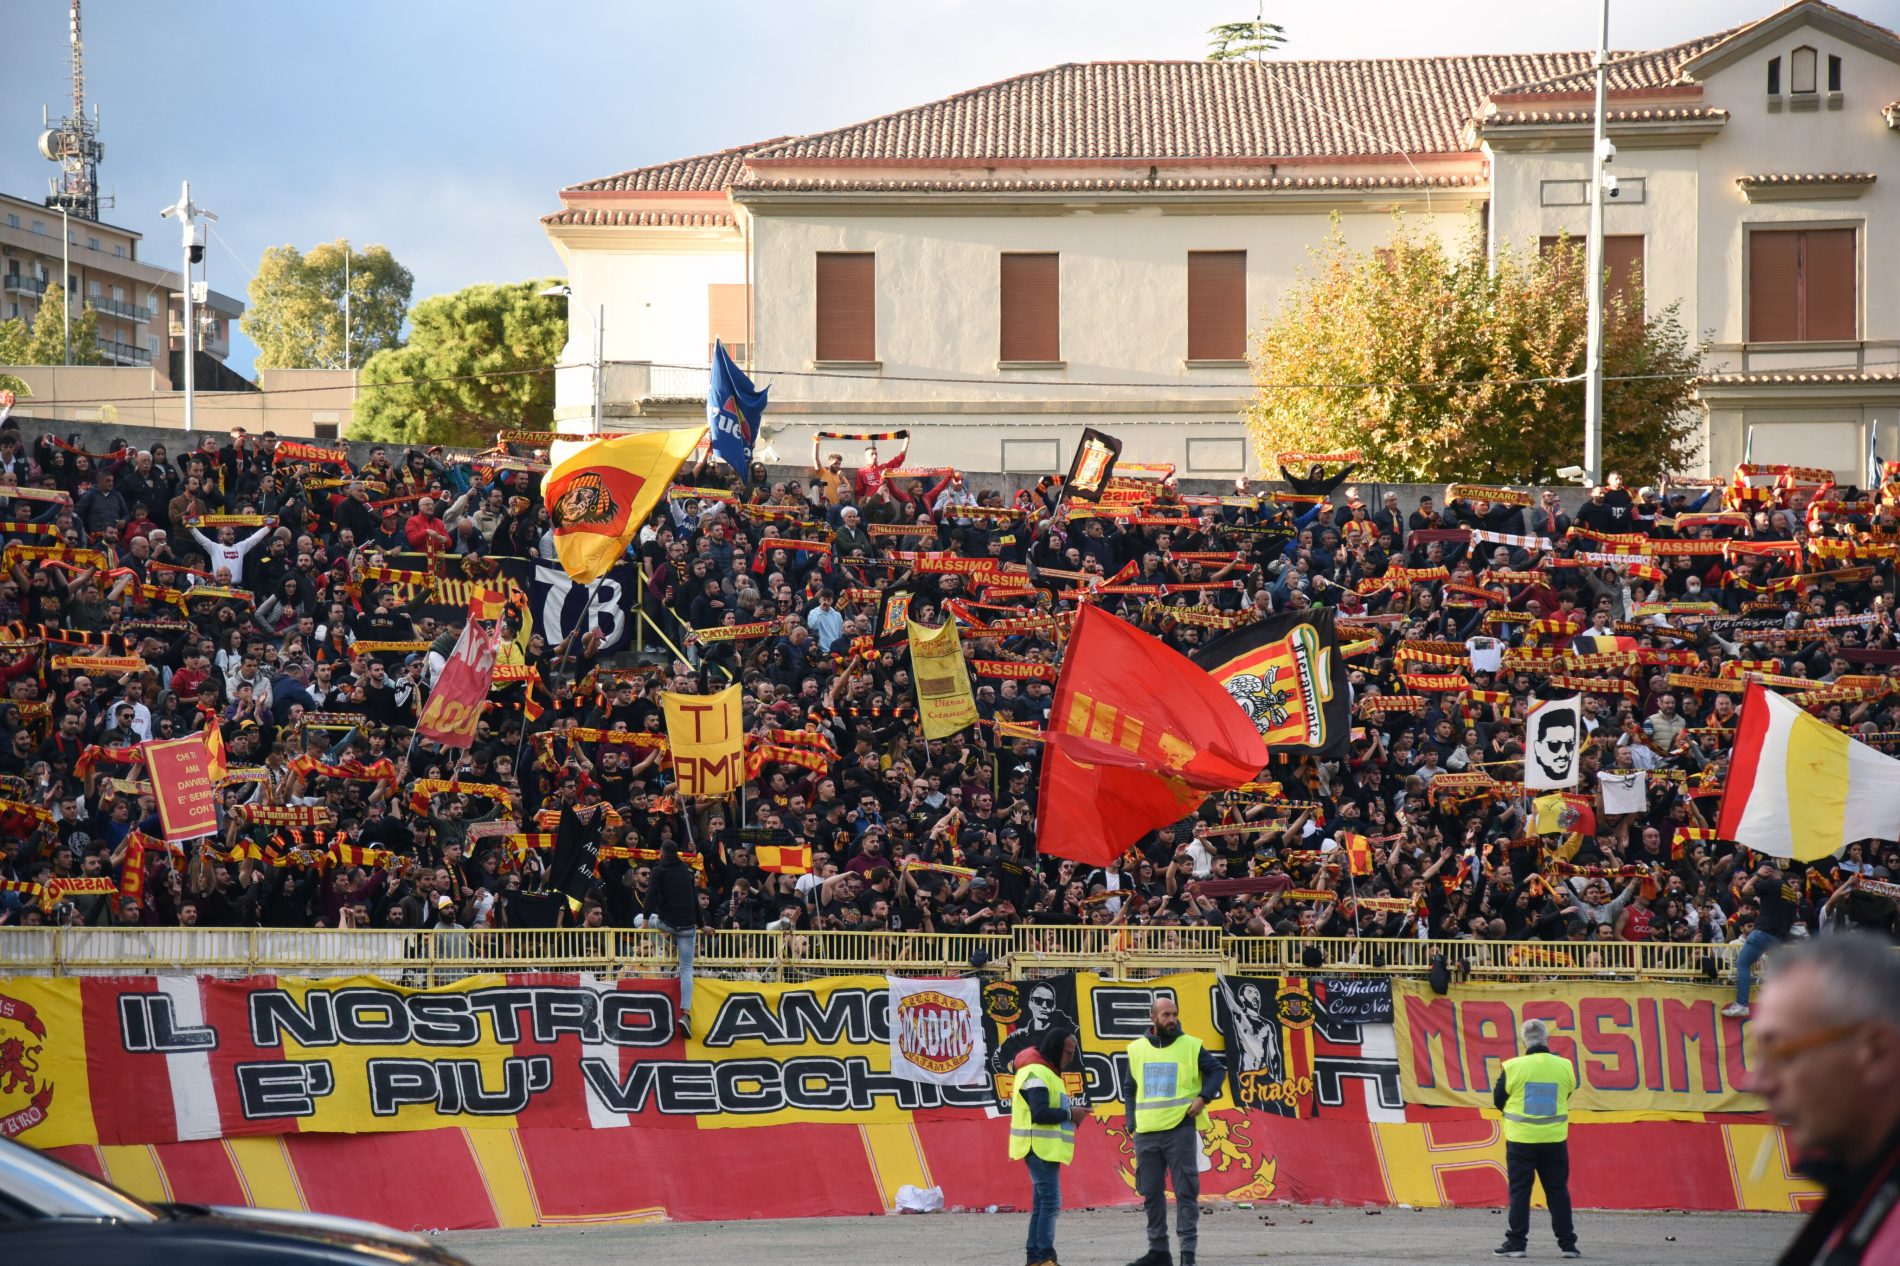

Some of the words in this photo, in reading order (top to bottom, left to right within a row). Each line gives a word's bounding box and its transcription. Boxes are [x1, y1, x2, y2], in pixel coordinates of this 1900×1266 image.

[1460, 488, 1517, 500] CATANZARO
[1651, 541, 1724, 553] MASSIMO
[920, 560, 993, 572] MASSIMO
[701, 625, 765, 640] CATANZARO
[1293, 643, 1318, 738] Fieramente
[934, 698, 966, 708] Ultras
[680, 703, 728, 743] TI
[176, 752, 190, 762] CHI
[185, 765, 200, 774] AMA
[178, 777, 209, 790] DAVVERO
[1436, 775, 1469, 783] ULTRAS
[189, 806, 208, 817] CON
[1327, 979, 1389, 998] Diffidati
[1330, 998, 1357, 1015] Con
[1361, 998, 1392, 1015] Noi
[118, 992, 219, 1053] IL
[249, 986, 675, 1047] NOSTRO
[1145, 1065, 1175, 1079] STEWARD
[235, 1060, 334, 1120] E'
[367, 1056, 554, 1118] PIU'
